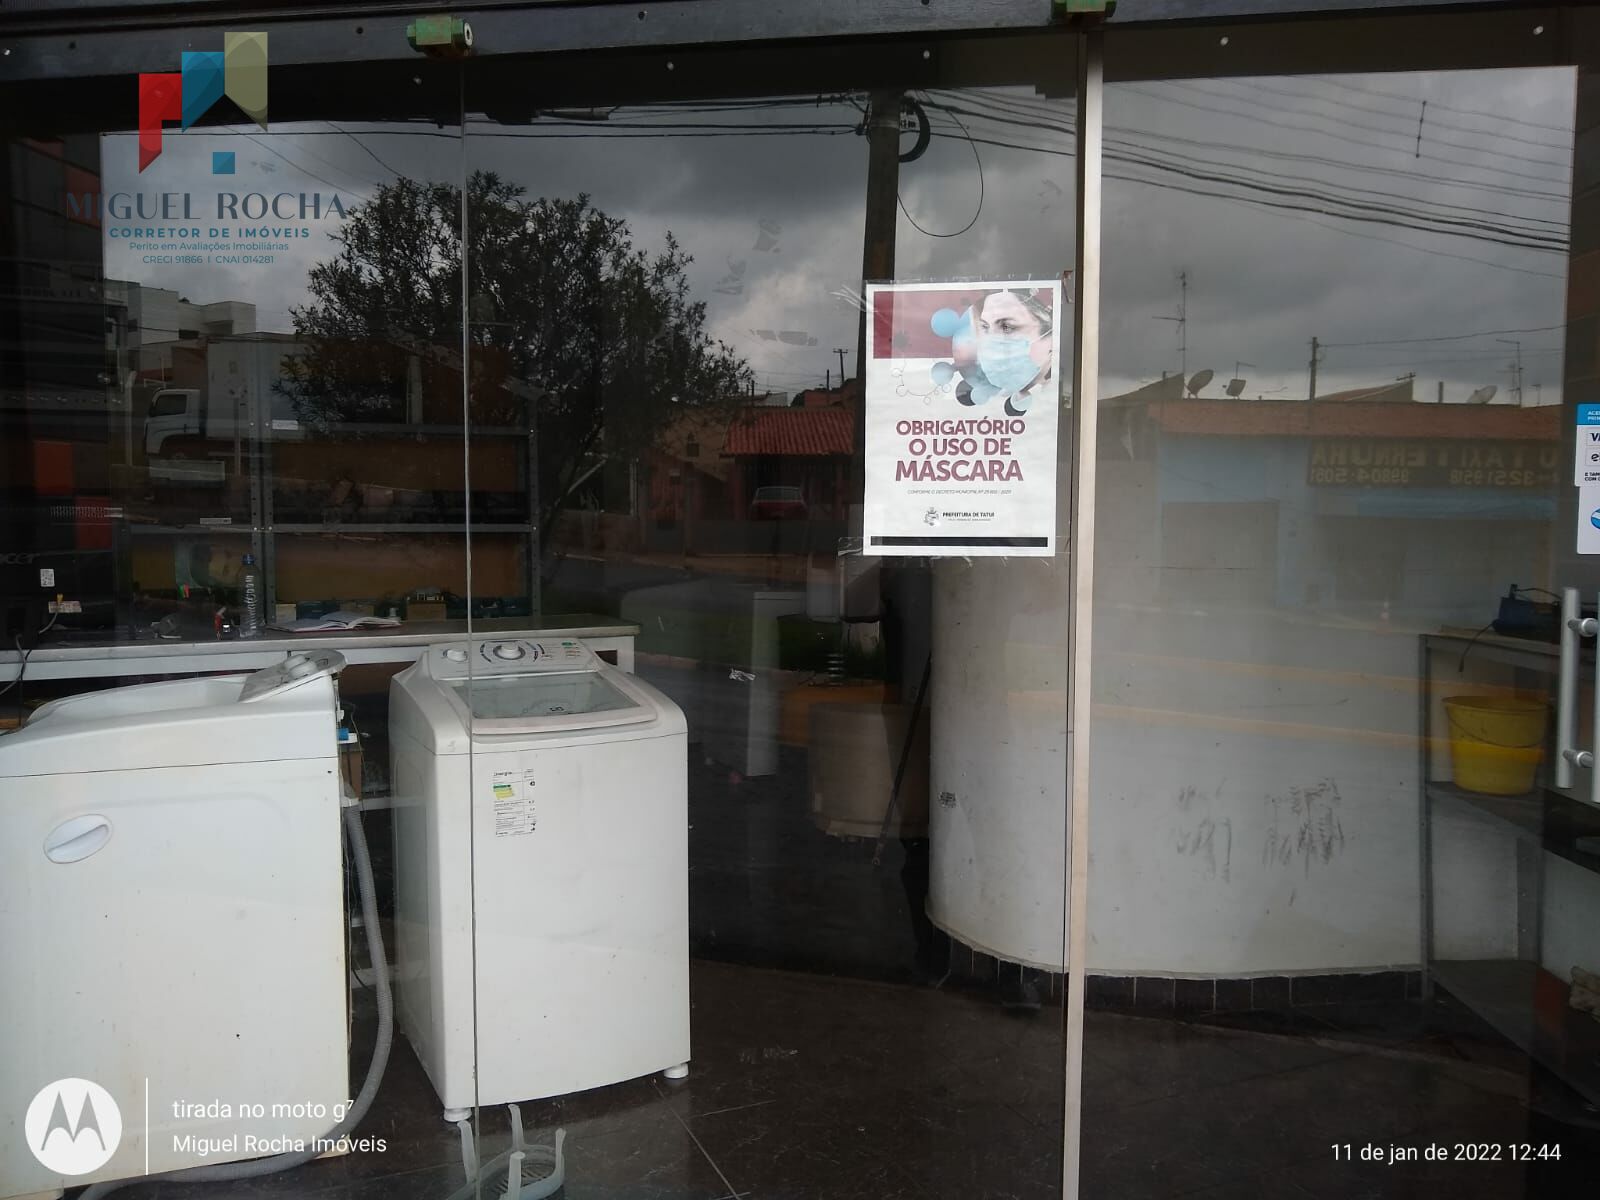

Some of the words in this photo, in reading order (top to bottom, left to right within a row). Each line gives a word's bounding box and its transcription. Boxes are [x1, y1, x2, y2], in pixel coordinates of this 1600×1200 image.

[895, 416, 1025, 435] OBRIGATÓRIO
[908, 438, 927, 456] O
[932, 438, 978, 456] USO
[983, 437, 1012, 456] DE
[895, 455, 1024, 482] MÁSCARA
